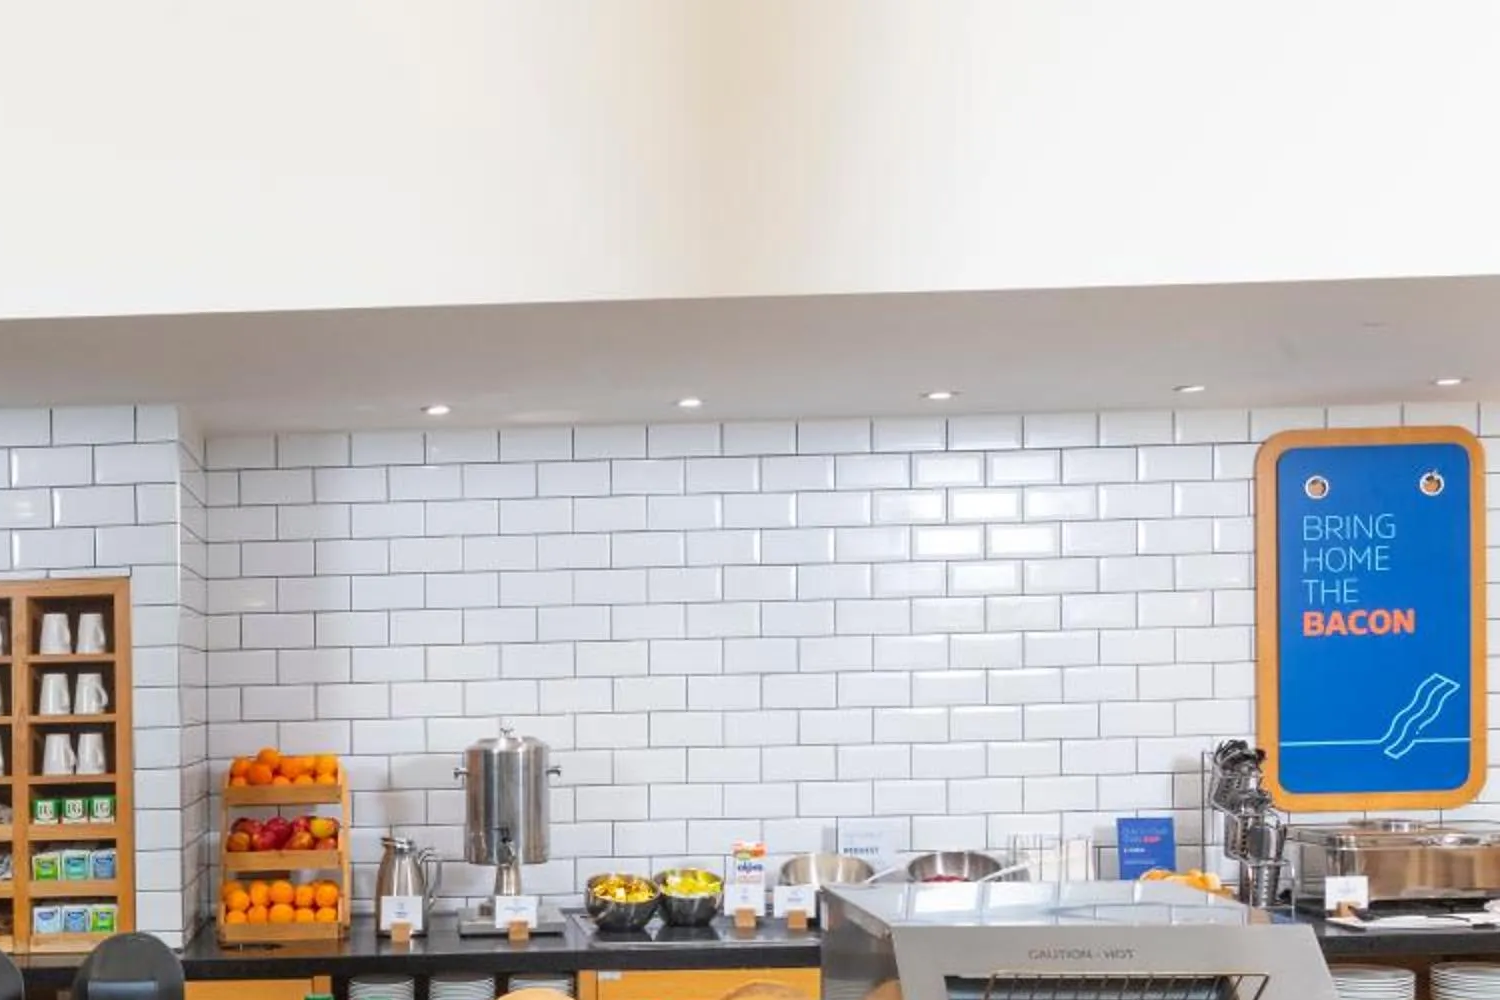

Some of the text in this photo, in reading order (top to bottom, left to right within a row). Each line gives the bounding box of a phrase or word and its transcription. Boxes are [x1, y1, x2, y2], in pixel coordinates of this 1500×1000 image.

[1302, 513, 1397, 542] BRING
[1302, 545, 1392, 573] HOME
[1302, 578, 1360, 604] THE
[1302, 607, 1416, 637] BACON
[1027, 948, 1093, 960] CAUTION
